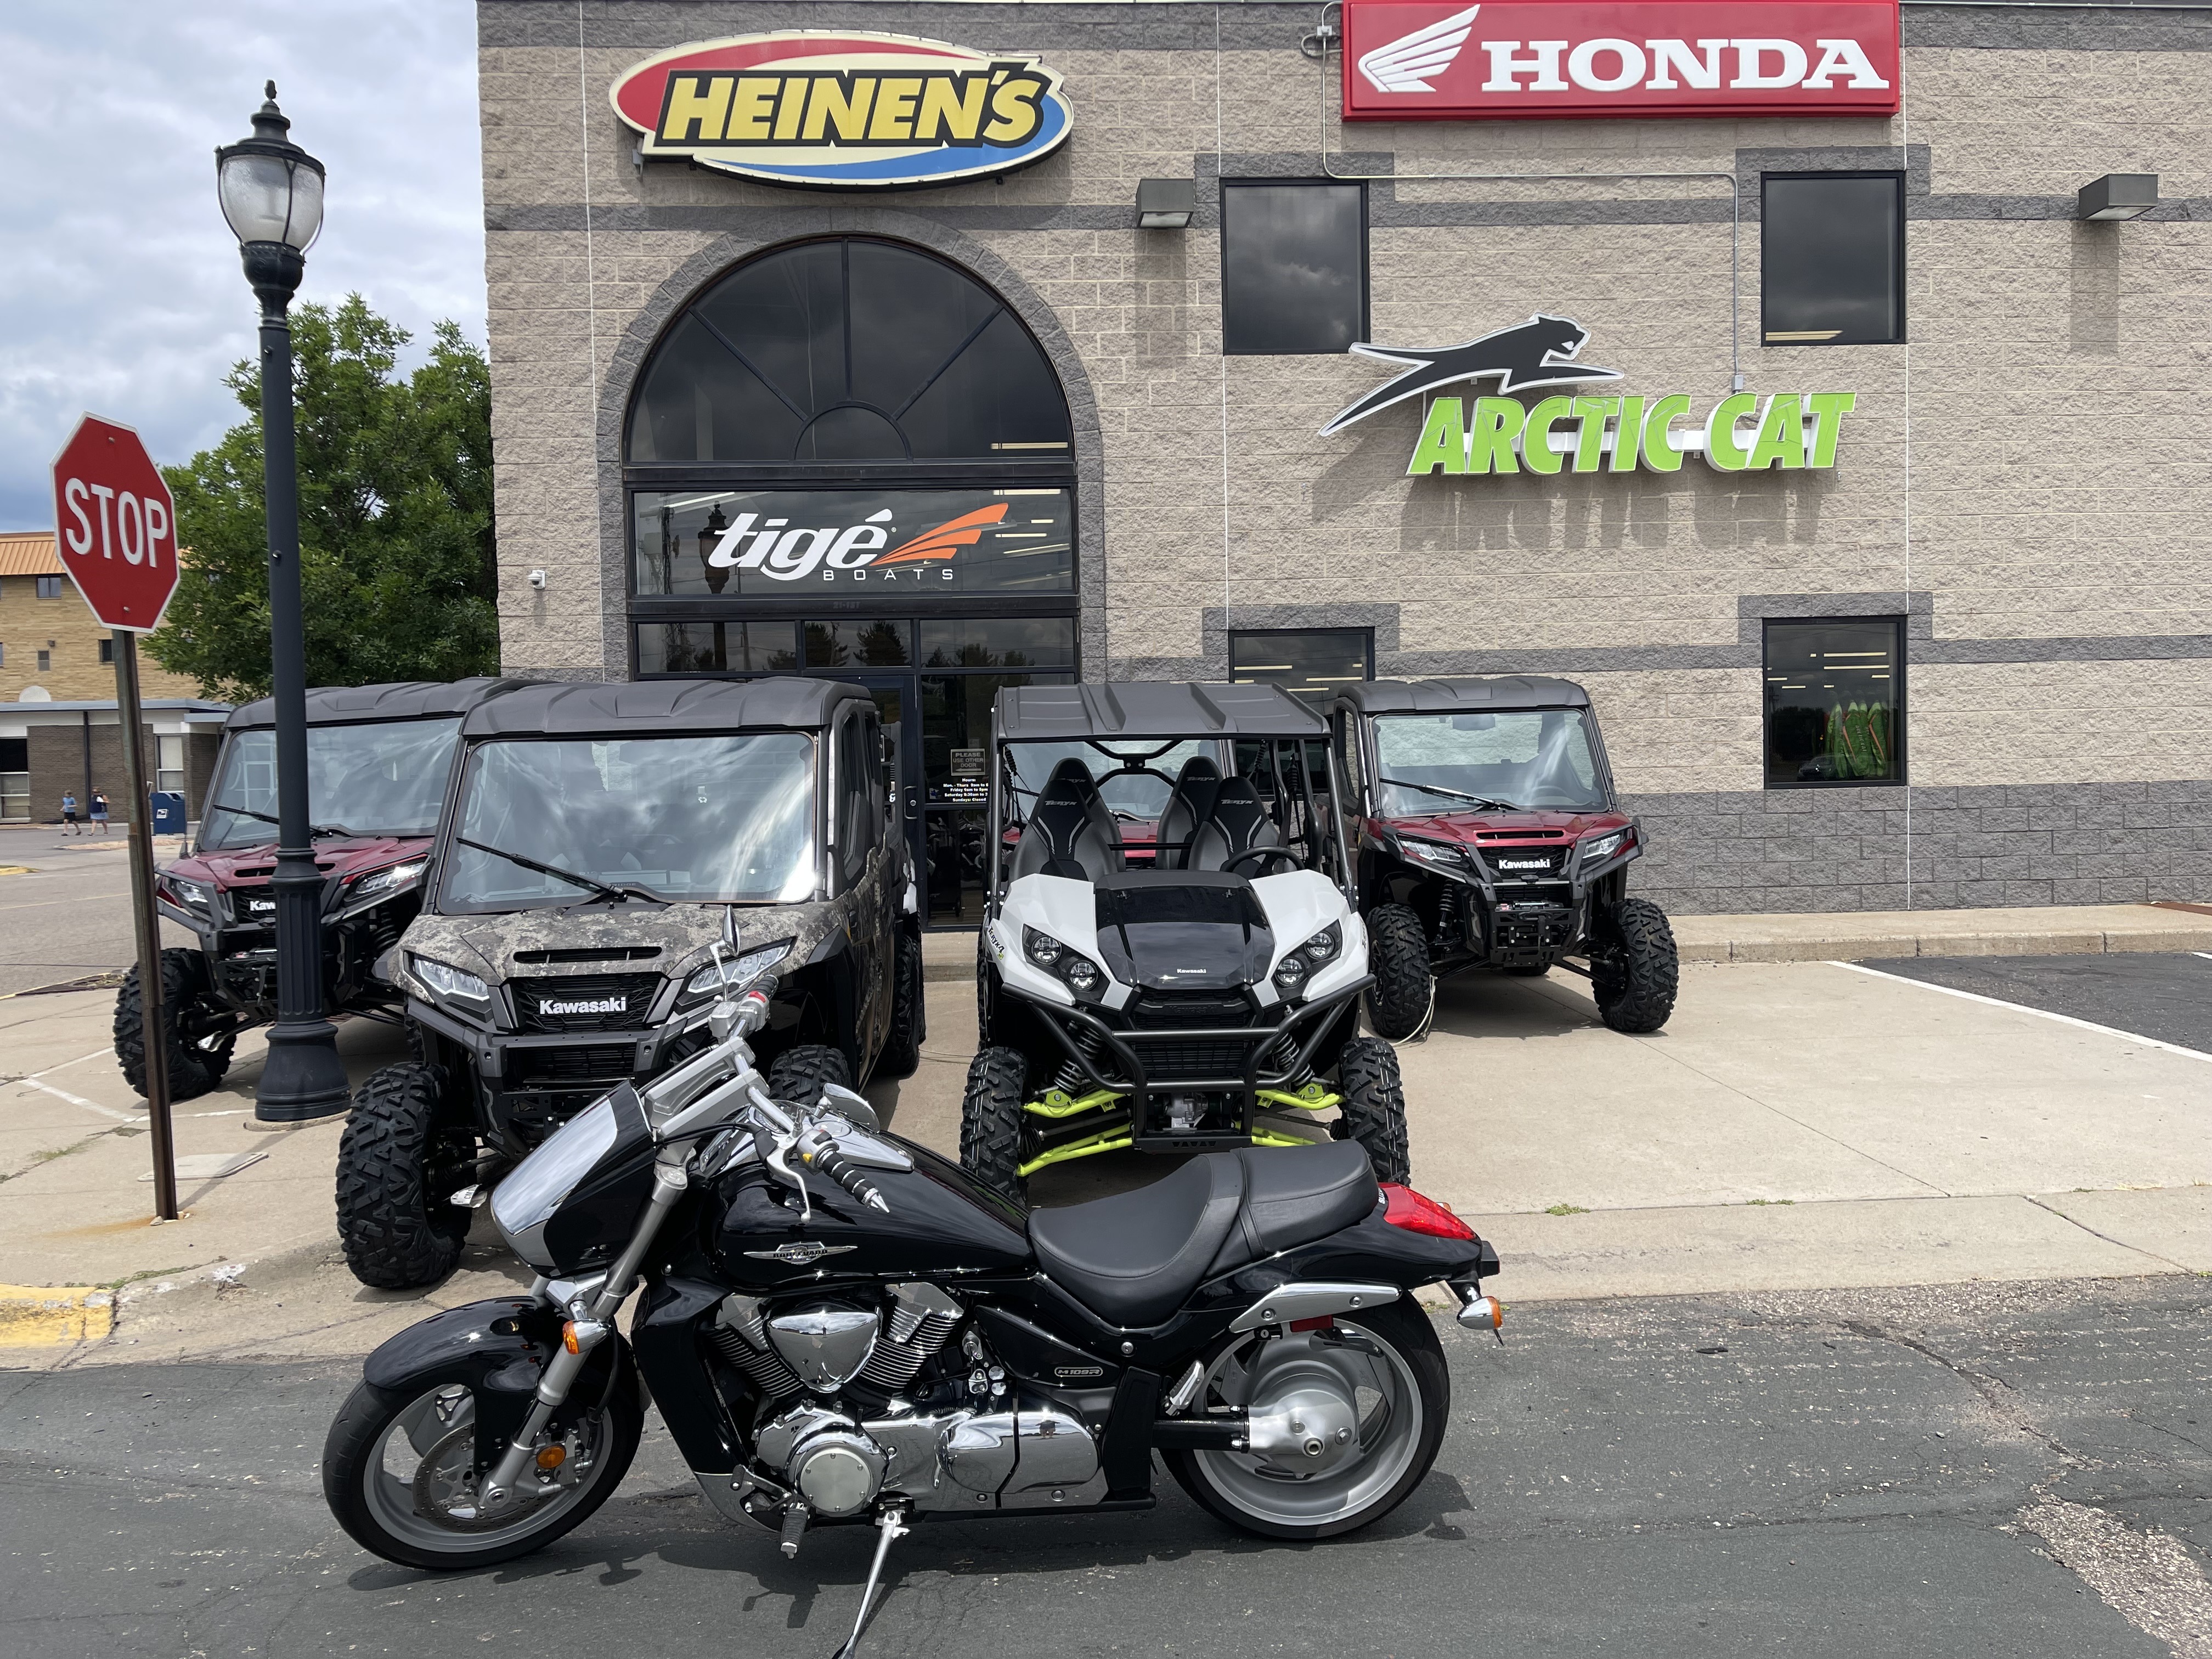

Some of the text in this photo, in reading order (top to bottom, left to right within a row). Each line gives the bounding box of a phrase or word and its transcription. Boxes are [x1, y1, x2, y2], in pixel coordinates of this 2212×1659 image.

[1481, 38, 1889, 92] HONDA
[662, 70, 1041, 142] HEINEN'S
[1407, 391, 1857, 475] ARCTIC CAT
[65, 477, 168, 567] STOP
[708, 509, 893, 581] tigé
[823, 569, 953, 580] BOATS
[1499, 859, 1550, 869] Kawasaki
[540, 997, 626, 1014] Kawasaki
